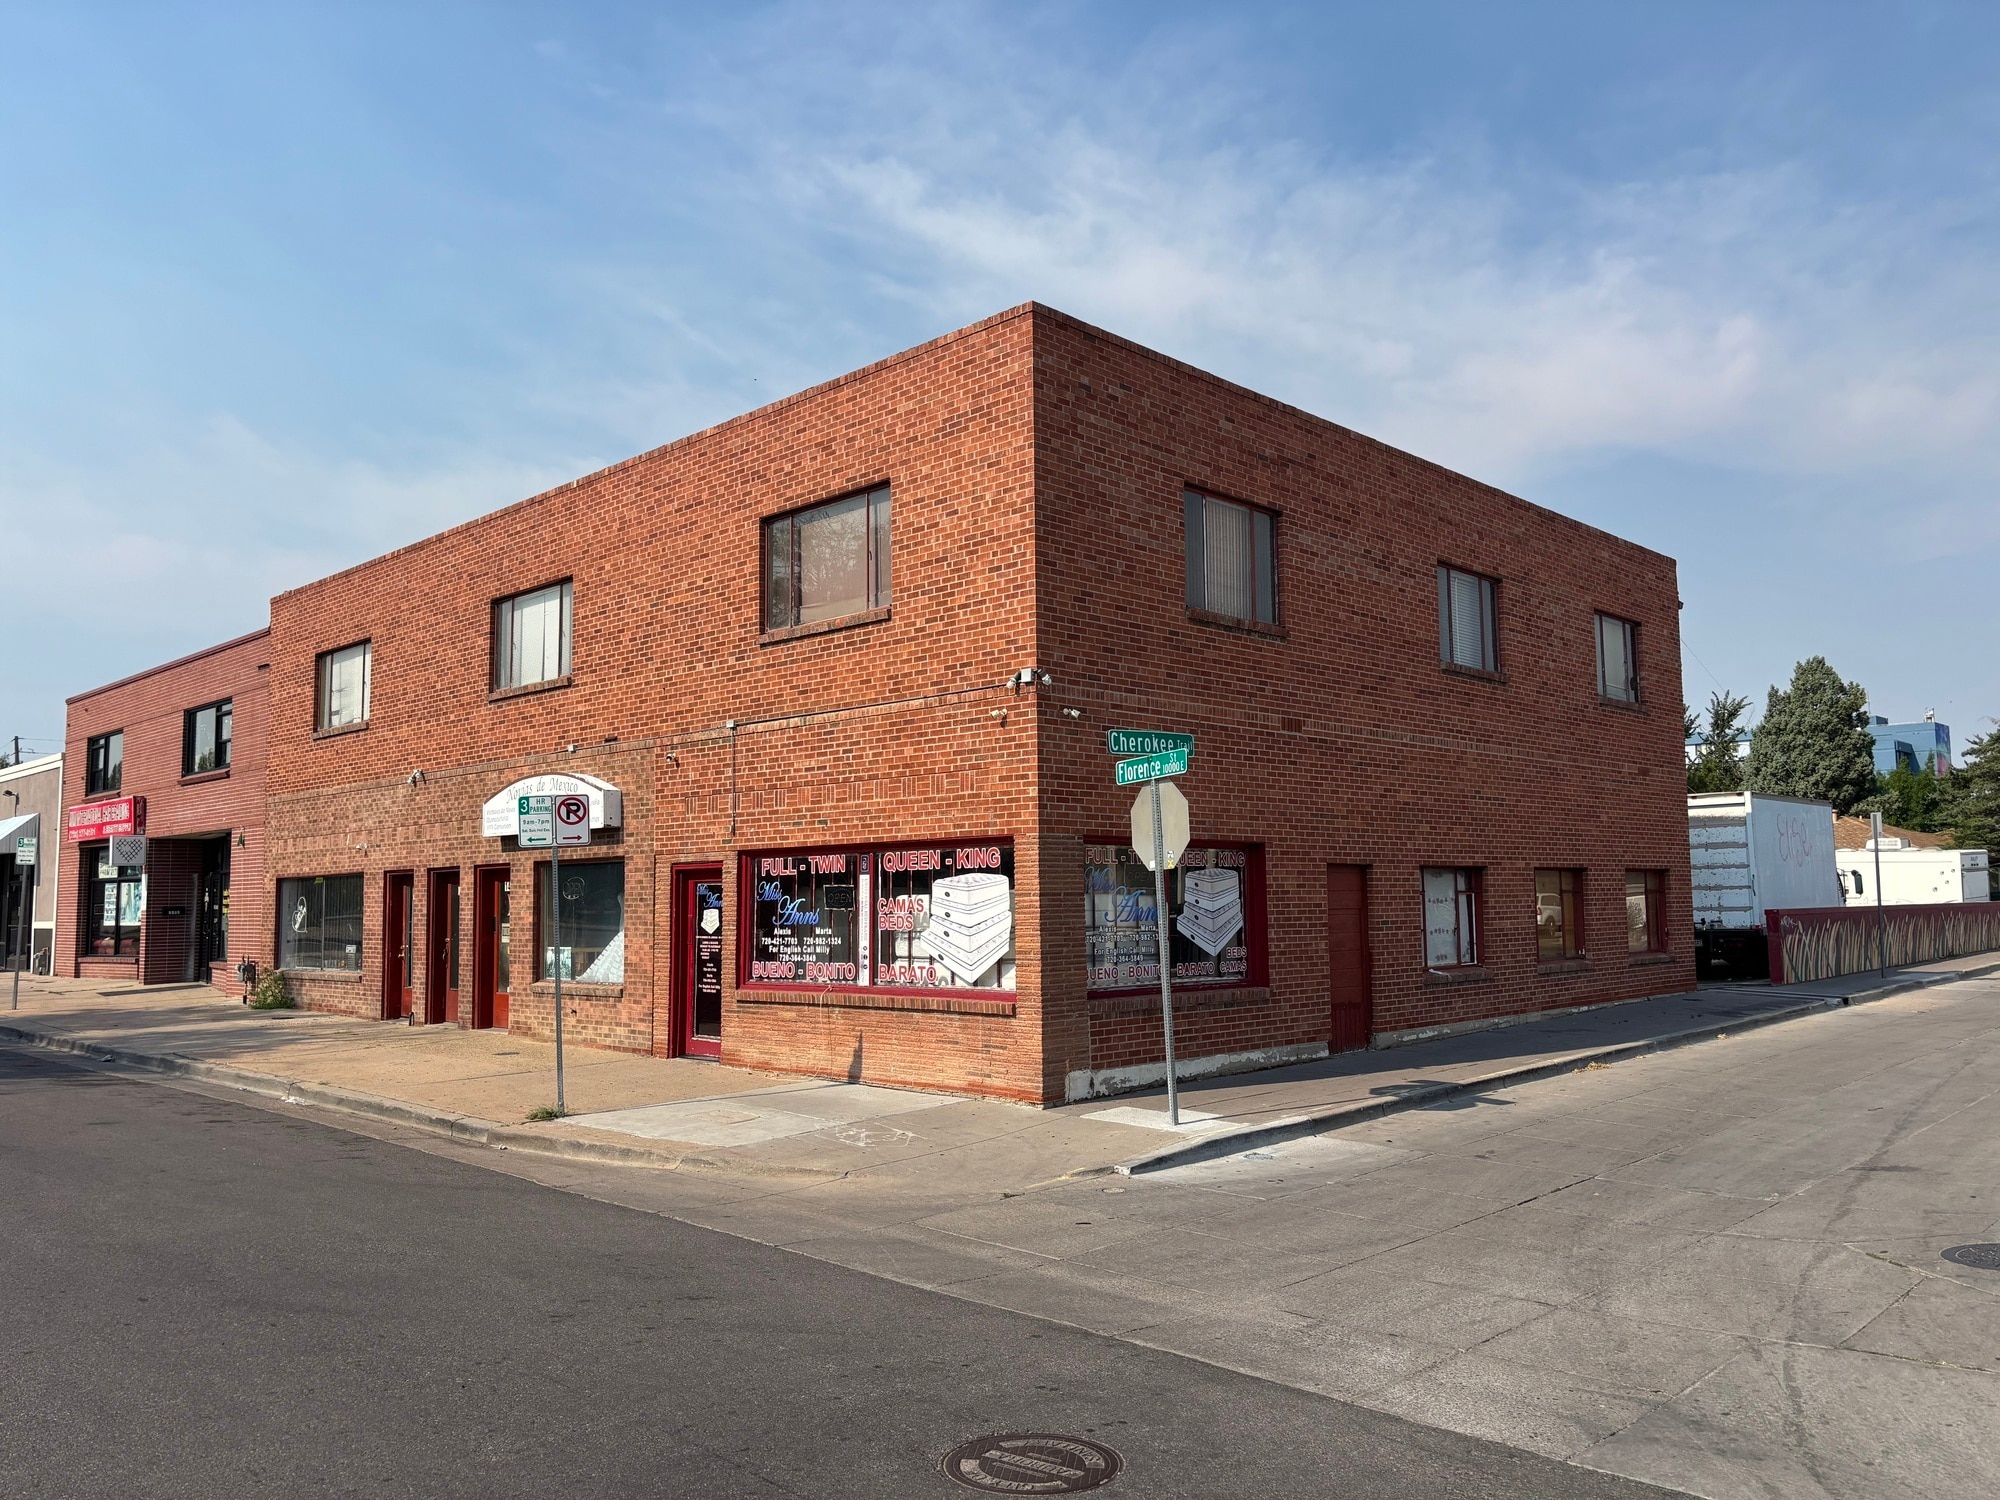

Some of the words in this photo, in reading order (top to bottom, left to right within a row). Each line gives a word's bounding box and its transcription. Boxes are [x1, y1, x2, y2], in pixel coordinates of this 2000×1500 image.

[1110, 732, 1174, 752] Cherokee
[1169, 753, 1177, 763] St
[1118, 760, 1161, 783] Florence
[536, 777, 546, 792] de
[549, 777, 579, 794] Mexico
[520, 799, 529, 813] 3
[535, 797, 546, 805] HR
[530, 805, 552, 813] PARKING
[883, 850, 941, 872] QUEEN
[956, 847, 1001, 869] KING
[1085, 847, 1118, 865] FULL
[1177, 851, 1209, 867] UEEN
[1218, 851, 1245, 867] KING
[761, 857, 797, 877] FULL
[808, 854, 846, 875] TWIN
[756, 881, 782, 902] Miss
[827, 892, 852, 904] OPEN
[772, 895, 820, 926] Anns
[877, 898, 924, 914] CAMAS
[815, 927, 832, 935] Marta
[878, 914, 914, 931] BEDS
[1098, 925, 1117, 933] Alexis
[1129, 933, 1159, 942] 720-982-13
[769, 945, 779, 953] For
[780, 945, 802, 955] English
[802, 945, 814, 953] Call
[1106, 947, 1128, 956] English
[1226, 946, 1247, 959] BEDS
[752, 960, 796, 978] BUENO
[806, 962, 856, 980] BONITO
[878, 963, 937, 983] BARATO
[1087, 965, 1119, 982] UENO
[1176, 961, 1215, 977] BARATO
[1219, 959, 1247, 973] CAMAS
